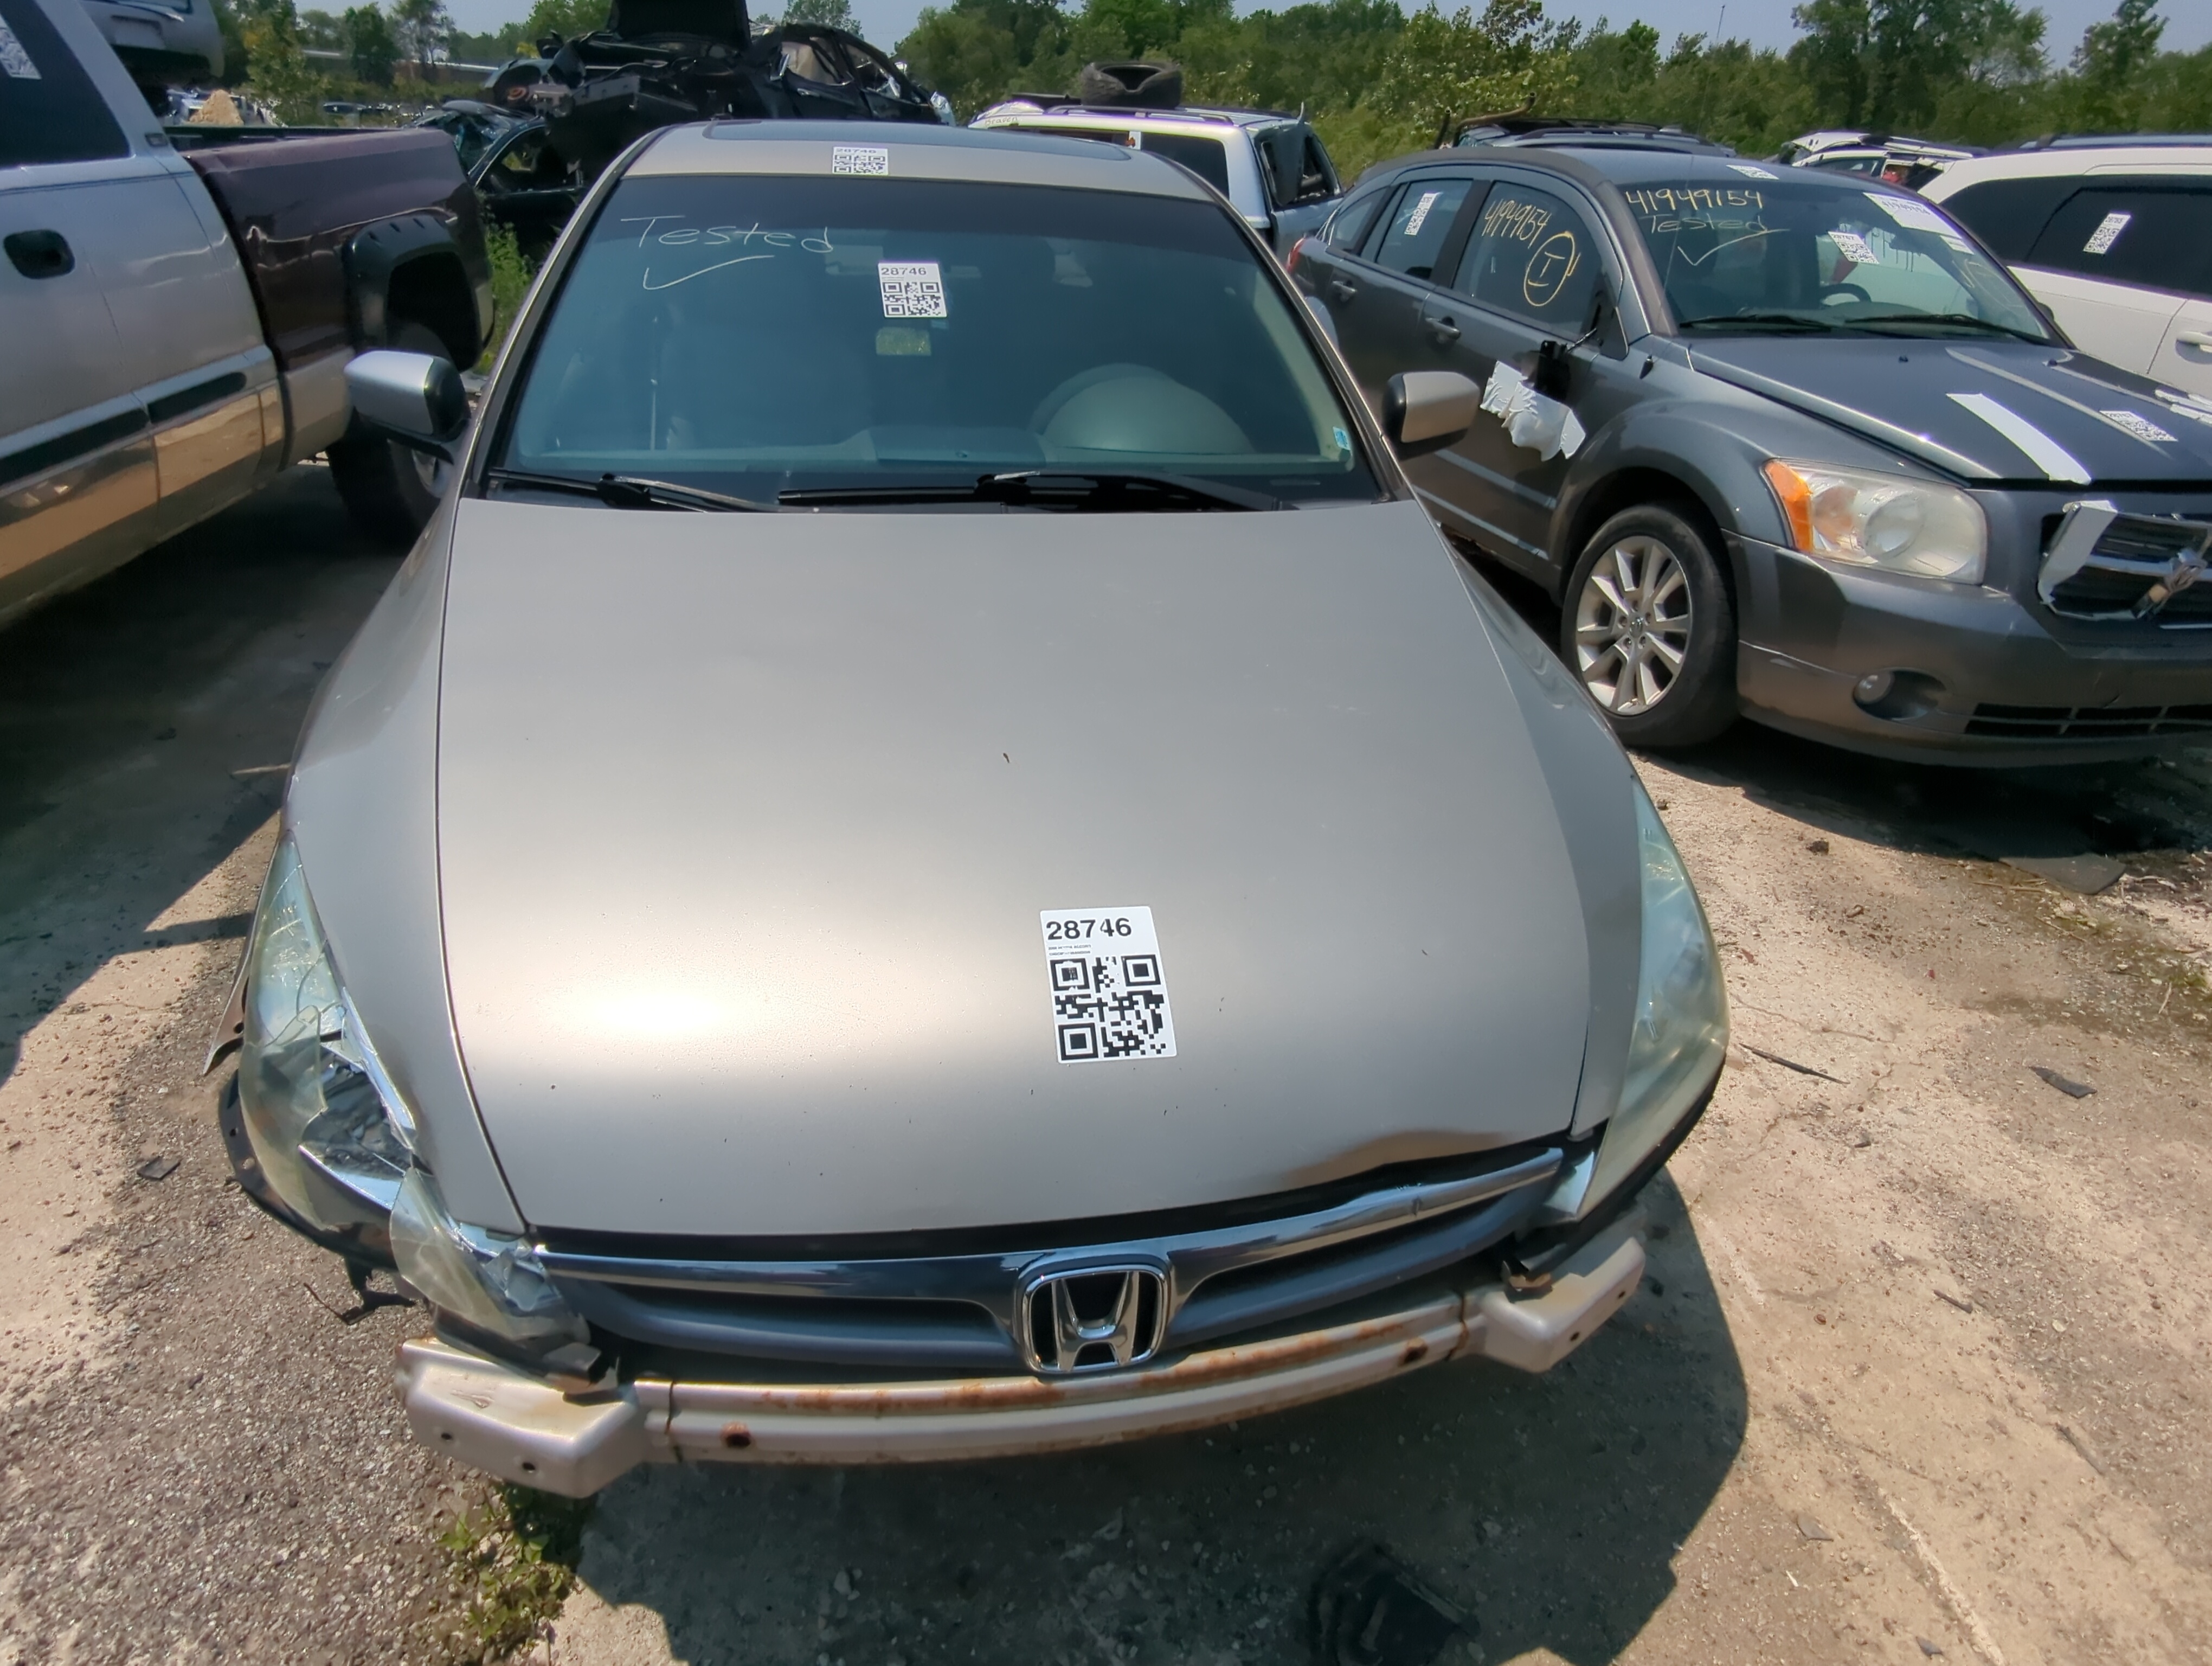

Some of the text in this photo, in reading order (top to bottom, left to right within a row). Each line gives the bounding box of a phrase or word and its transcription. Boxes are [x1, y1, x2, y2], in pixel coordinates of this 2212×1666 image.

[1625, 188, 1763, 214] 41949154
[620, 215, 834, 253] Tested
[1638, 213, 1768, 234] Tested
[880, 267, 927, 275] 28746
[1046, 918, 1132, 940] 28746
